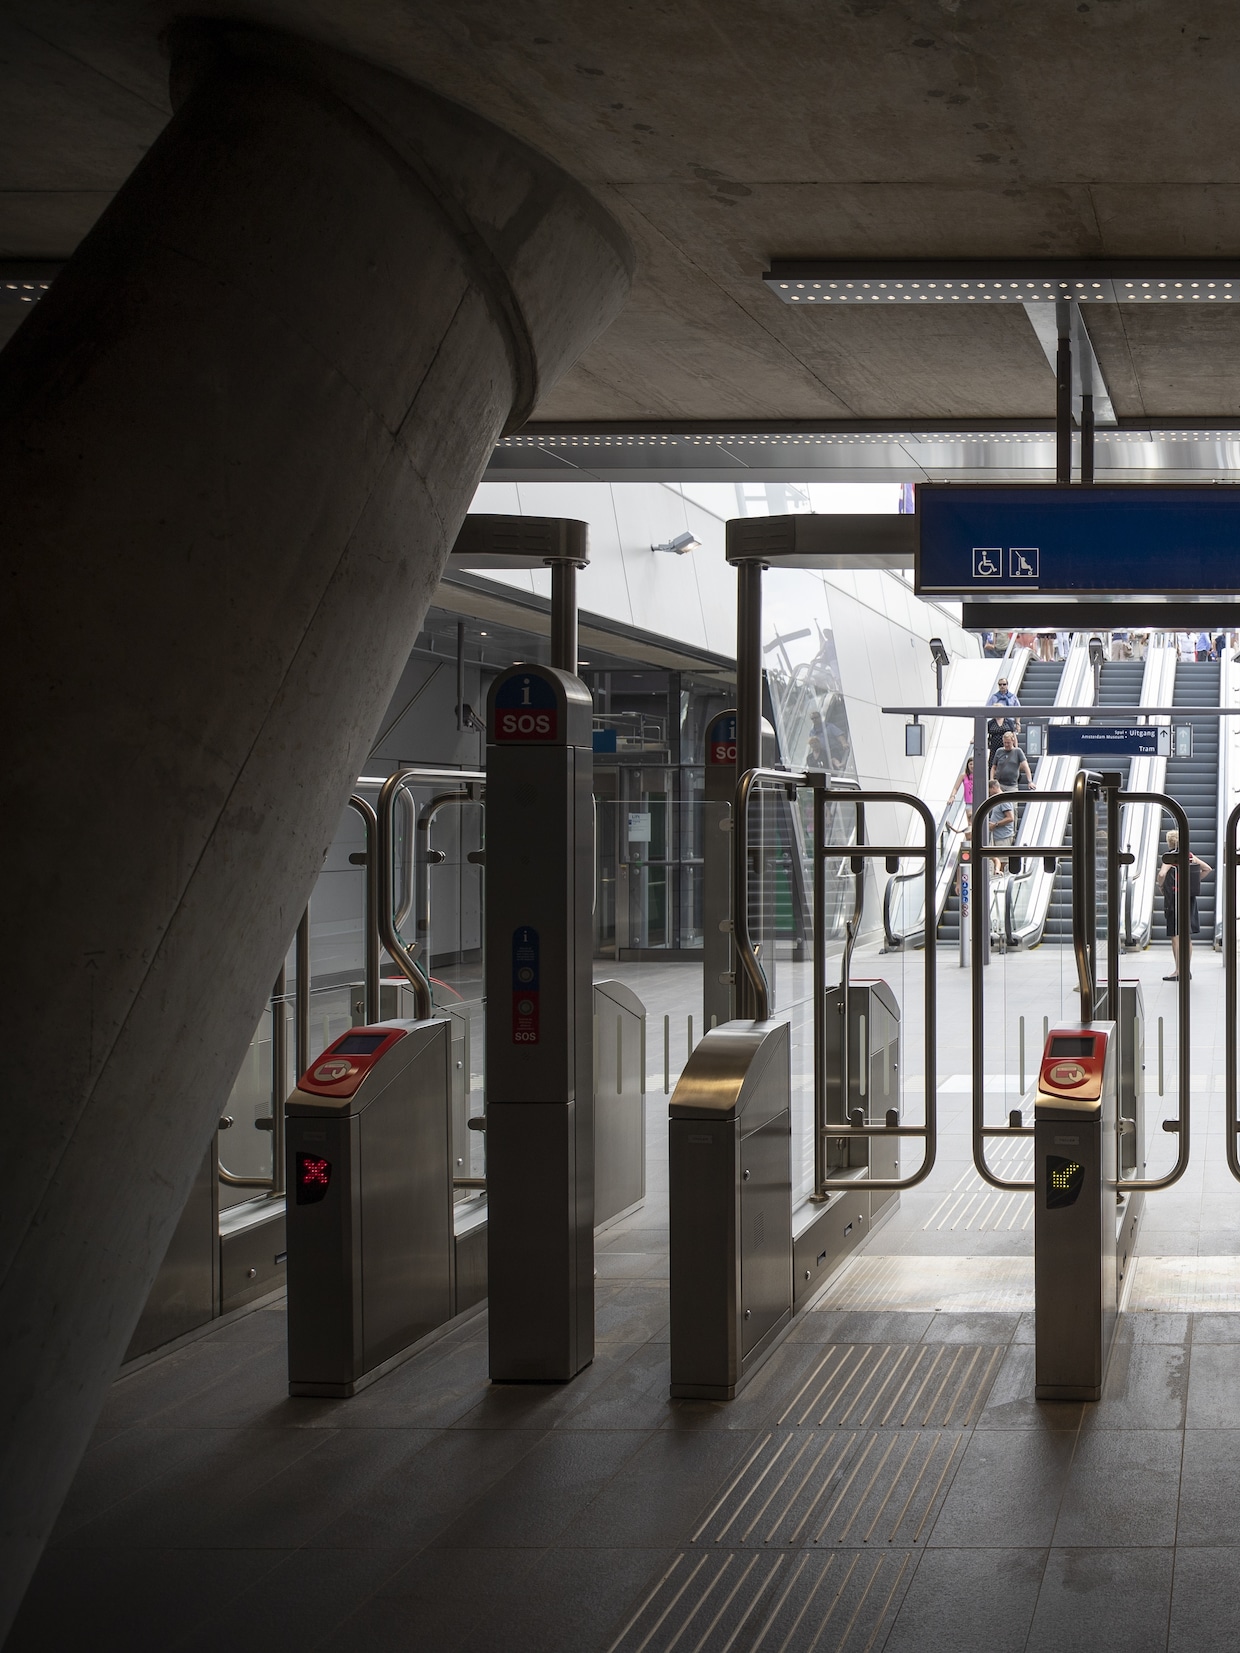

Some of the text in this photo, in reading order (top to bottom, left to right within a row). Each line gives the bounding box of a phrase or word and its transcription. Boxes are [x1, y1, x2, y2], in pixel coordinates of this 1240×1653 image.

[502, 714, 550, 734] SOS
[1129, 730, 1156, 738] Uitgang
[716, 746, 737, 760] SO
[515, 1032, 536, 1041] SOS
